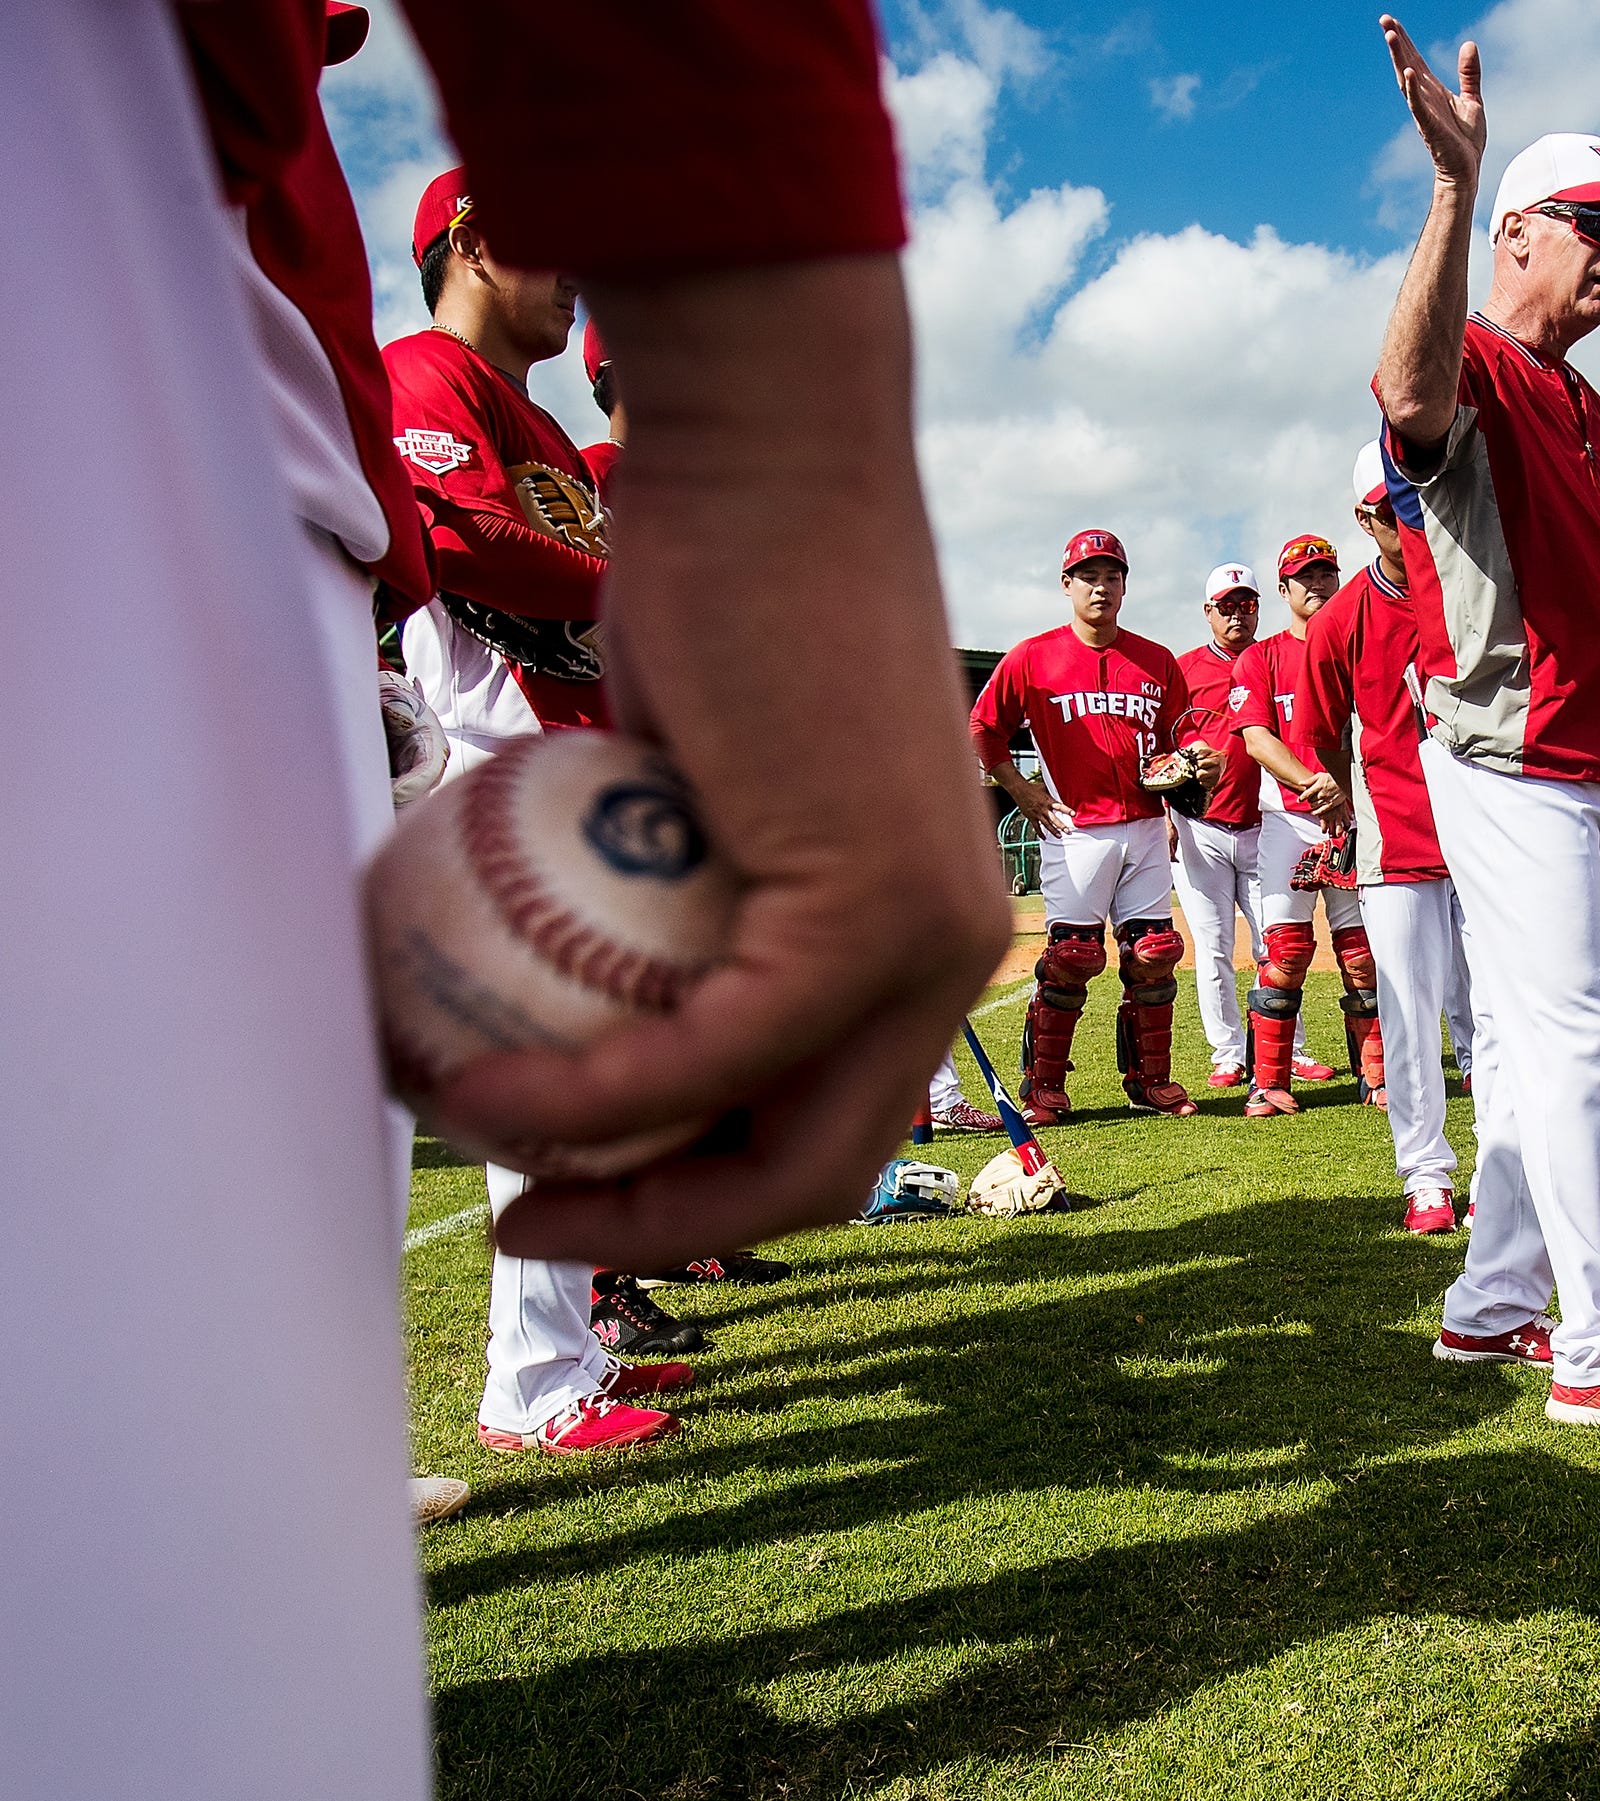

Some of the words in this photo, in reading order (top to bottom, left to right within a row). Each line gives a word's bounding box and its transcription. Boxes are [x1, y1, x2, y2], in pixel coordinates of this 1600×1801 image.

[398, 440, 466, 460] TIGERS
[1087, 534, 1108, 551] T
[1225, 570, 1244, 584] T
[1141, 682, 1162, 698] KIA
[1049, 691, 1162, 730] TIGERS
